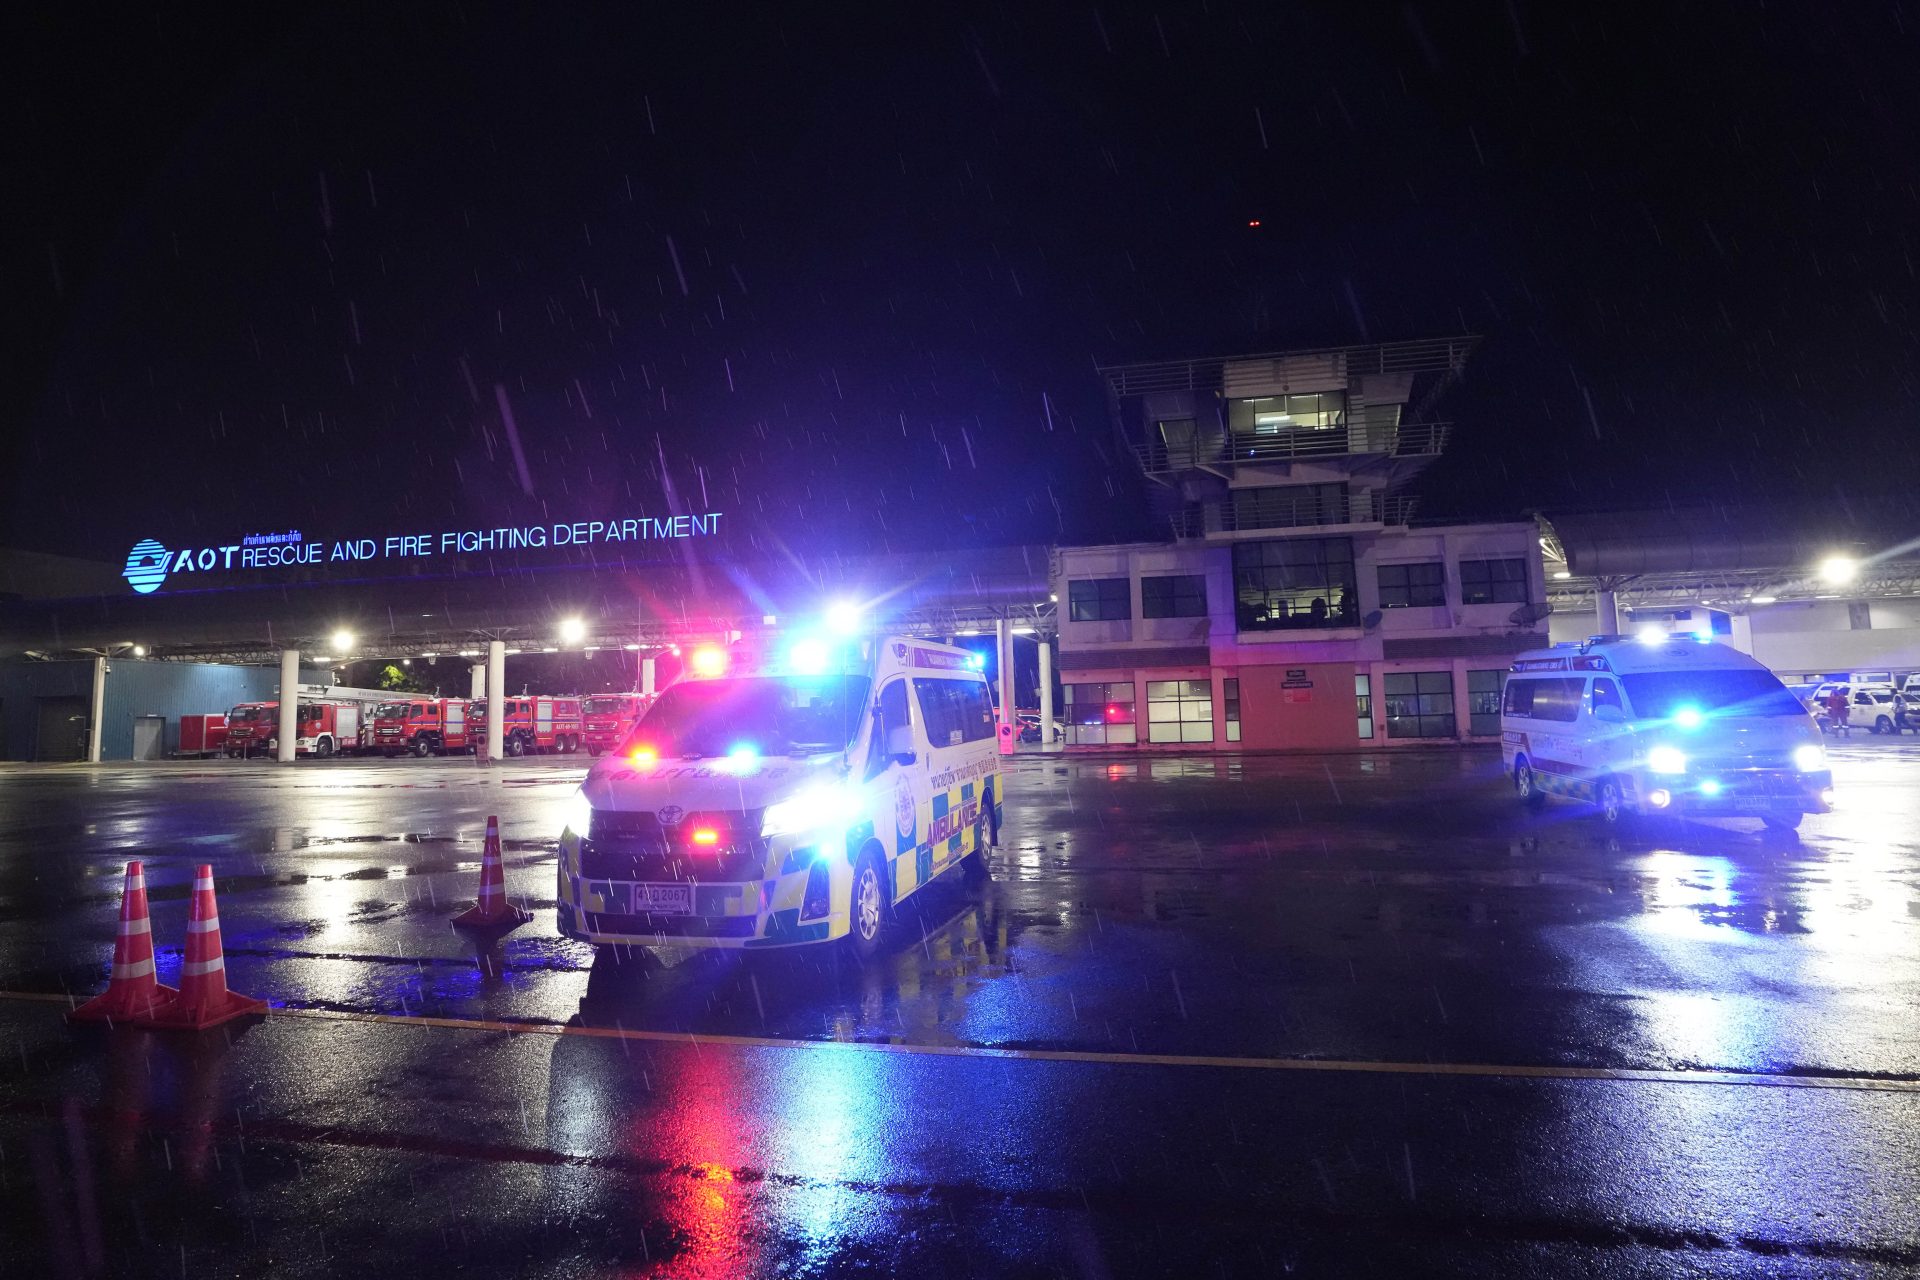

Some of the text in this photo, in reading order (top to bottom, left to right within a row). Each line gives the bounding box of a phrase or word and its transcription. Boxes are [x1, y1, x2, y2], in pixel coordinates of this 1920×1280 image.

[172, 513, 723, 573] AOT RESCUE AND FIRE FIGHTING DEPARTMENT
[926, 801, 978, 849] AMBULANCE
[661, 889, 687, 901] 2067
